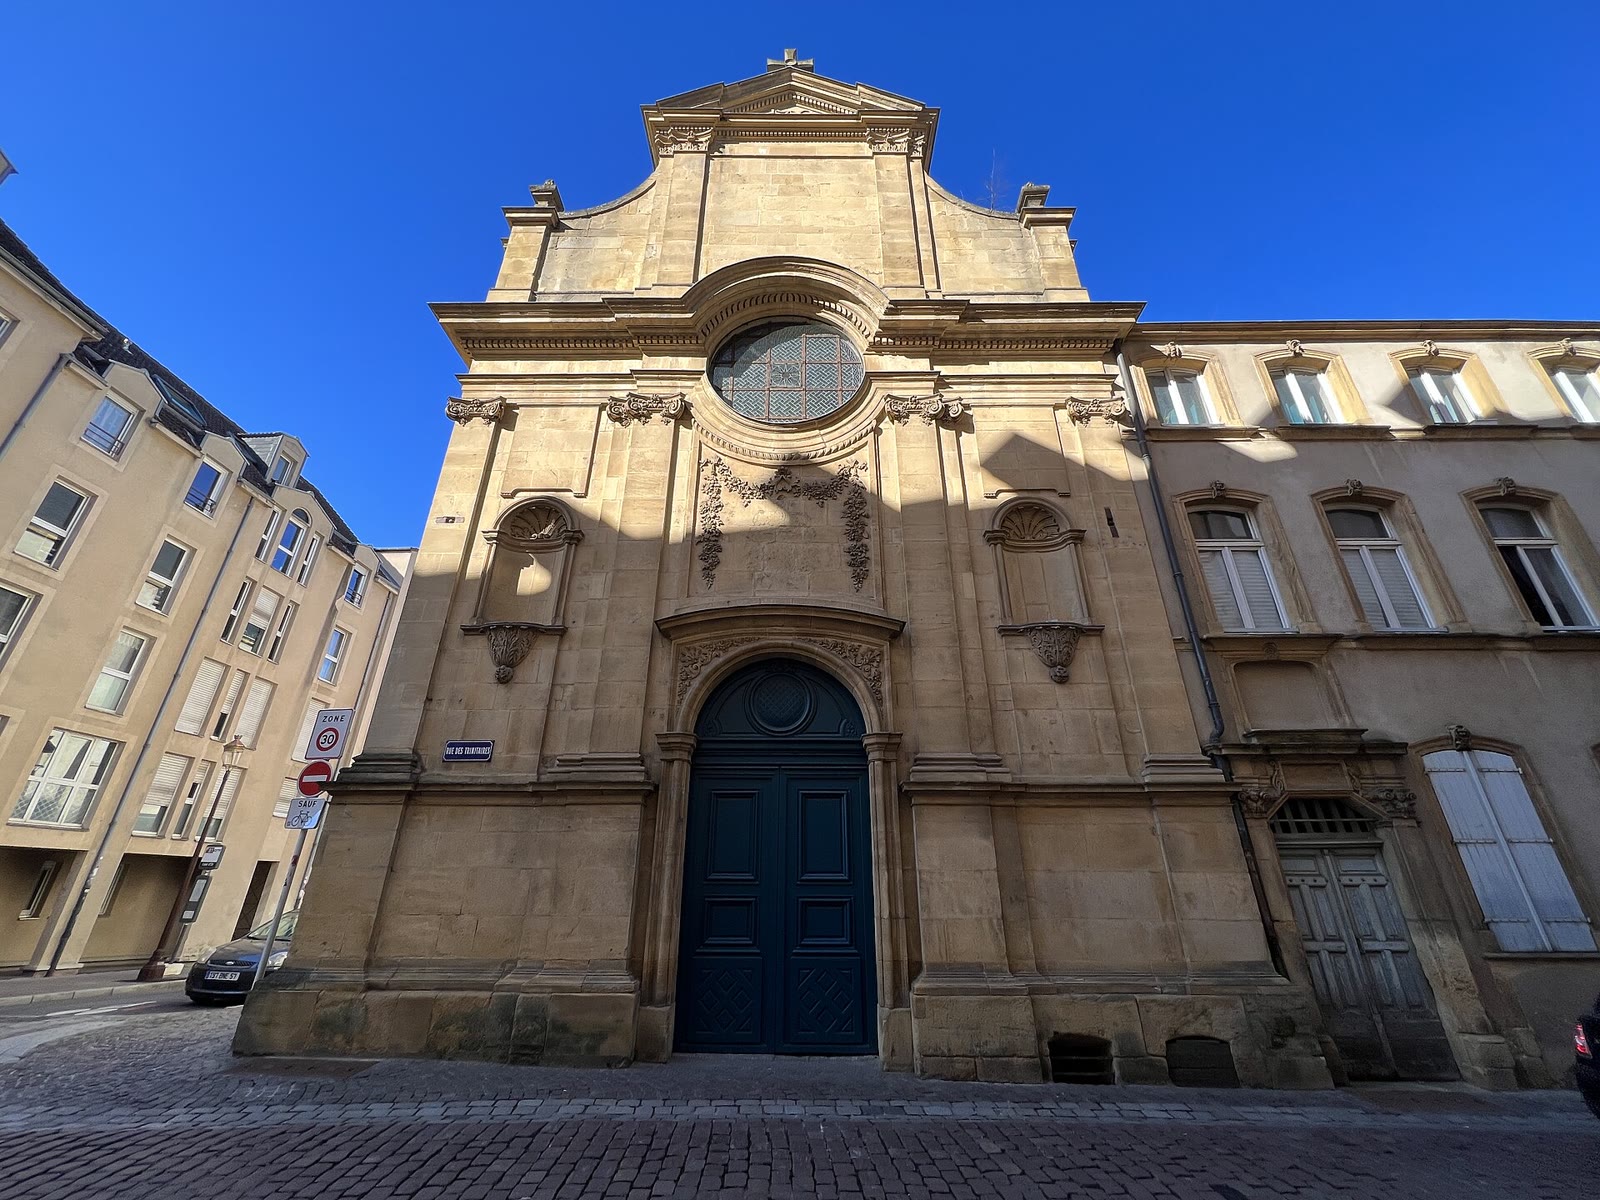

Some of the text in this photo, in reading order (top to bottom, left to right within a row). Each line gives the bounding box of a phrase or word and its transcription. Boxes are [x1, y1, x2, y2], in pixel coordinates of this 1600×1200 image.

[320, 734, 334, 744] 30
[446, 746, 454, 754] RUE
[455, 746, 464, 754] DES
